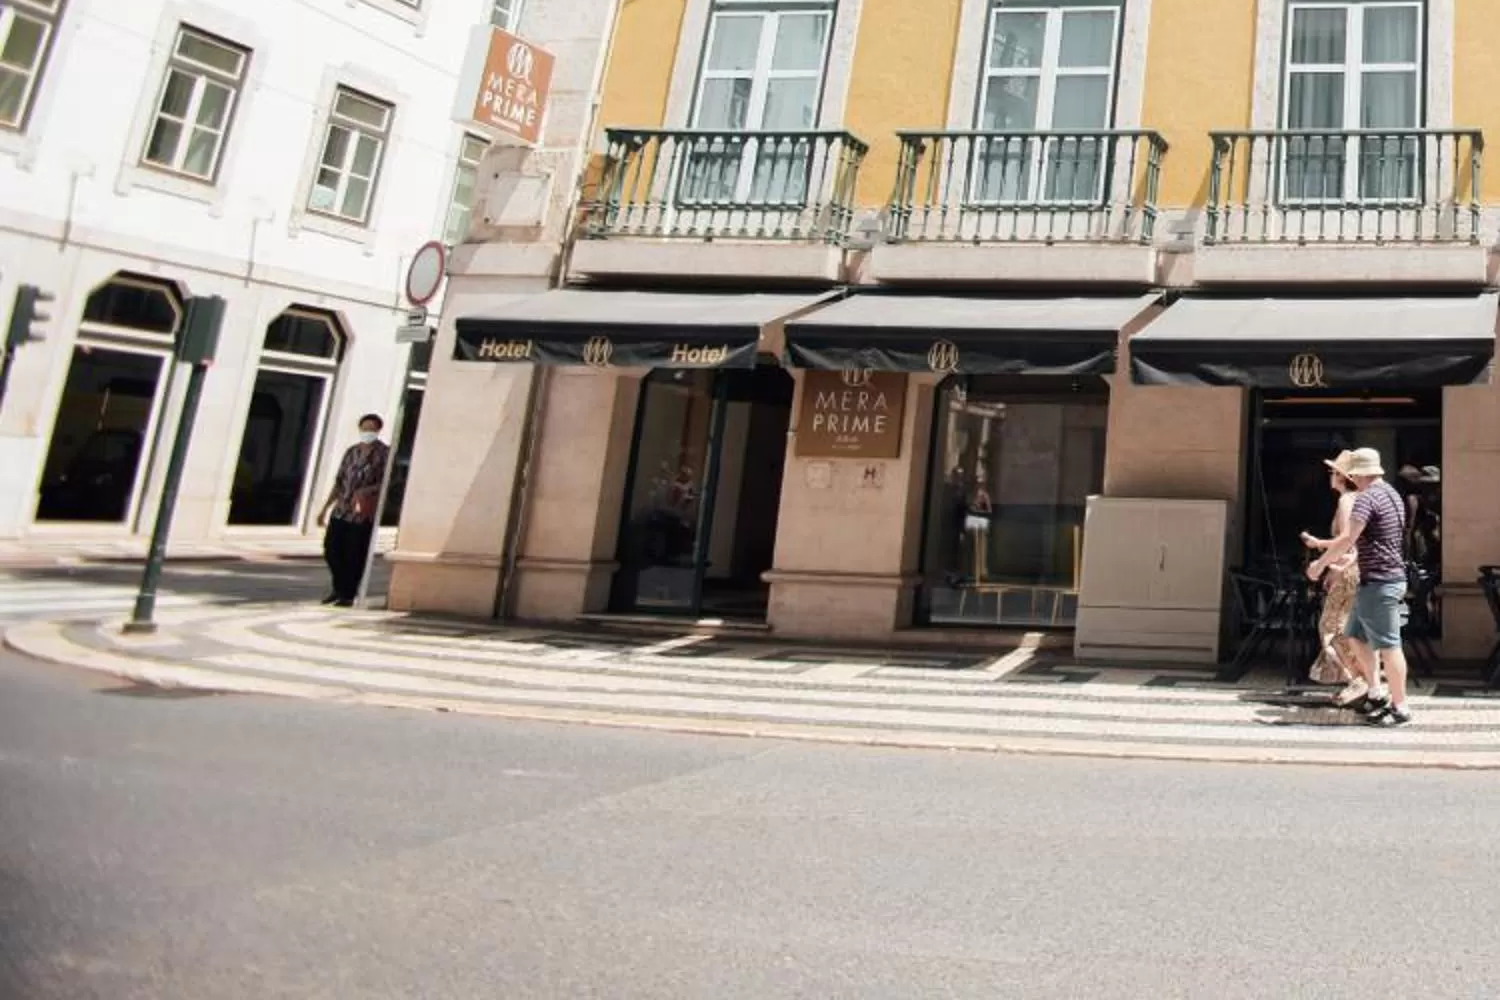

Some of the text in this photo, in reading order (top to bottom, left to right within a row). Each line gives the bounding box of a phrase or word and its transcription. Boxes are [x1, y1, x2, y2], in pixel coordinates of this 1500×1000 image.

[481, 89, 536, 126] PRIME
[479, 338, 533, 358] Hotel
[671, 343, 729, 364] Hotel
[814, 391, 889, 411] MERA
[812, 413, 889, 433] PRIME
